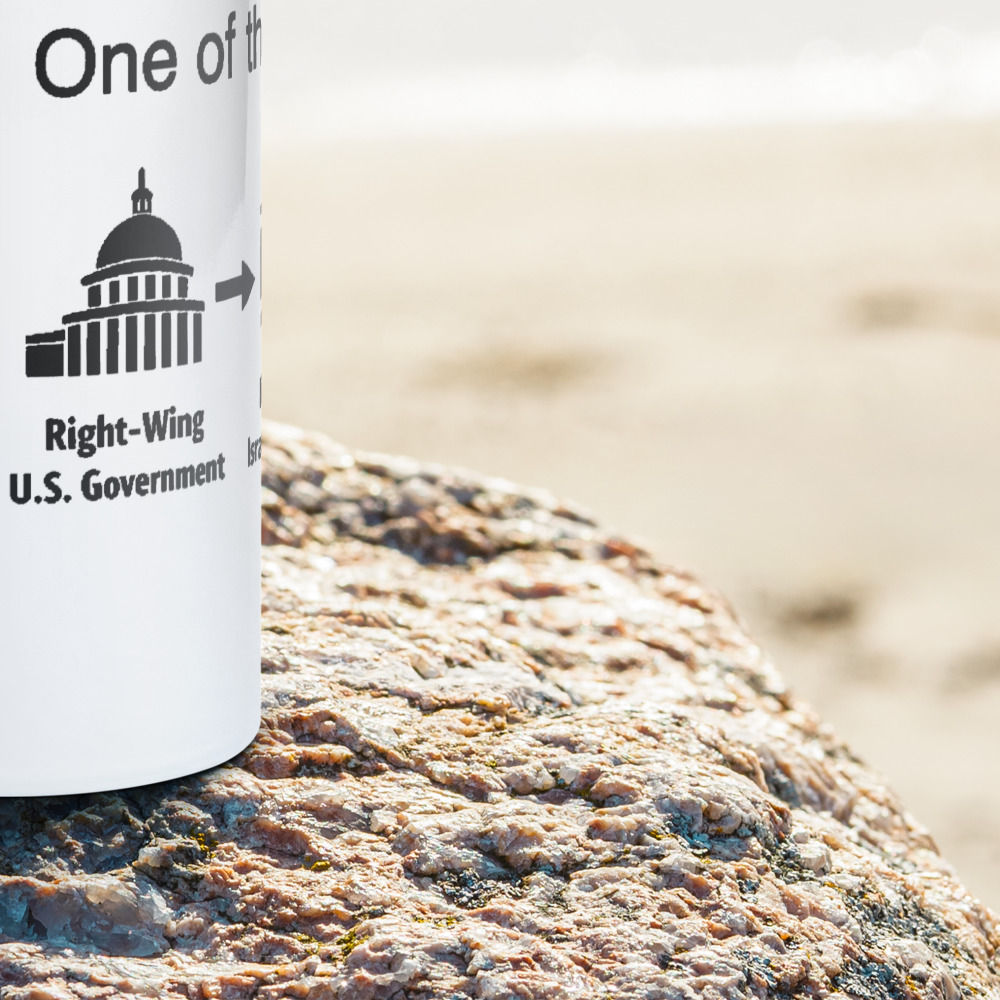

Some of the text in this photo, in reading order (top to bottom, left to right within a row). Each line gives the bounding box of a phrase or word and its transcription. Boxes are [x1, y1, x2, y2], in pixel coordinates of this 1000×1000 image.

[34, 27, 178, 99] One
[196, 10, 237, 85] of
[45, 405, 205, 459] Right-Wing
[9, 452, 226, 506] U.S. Government
